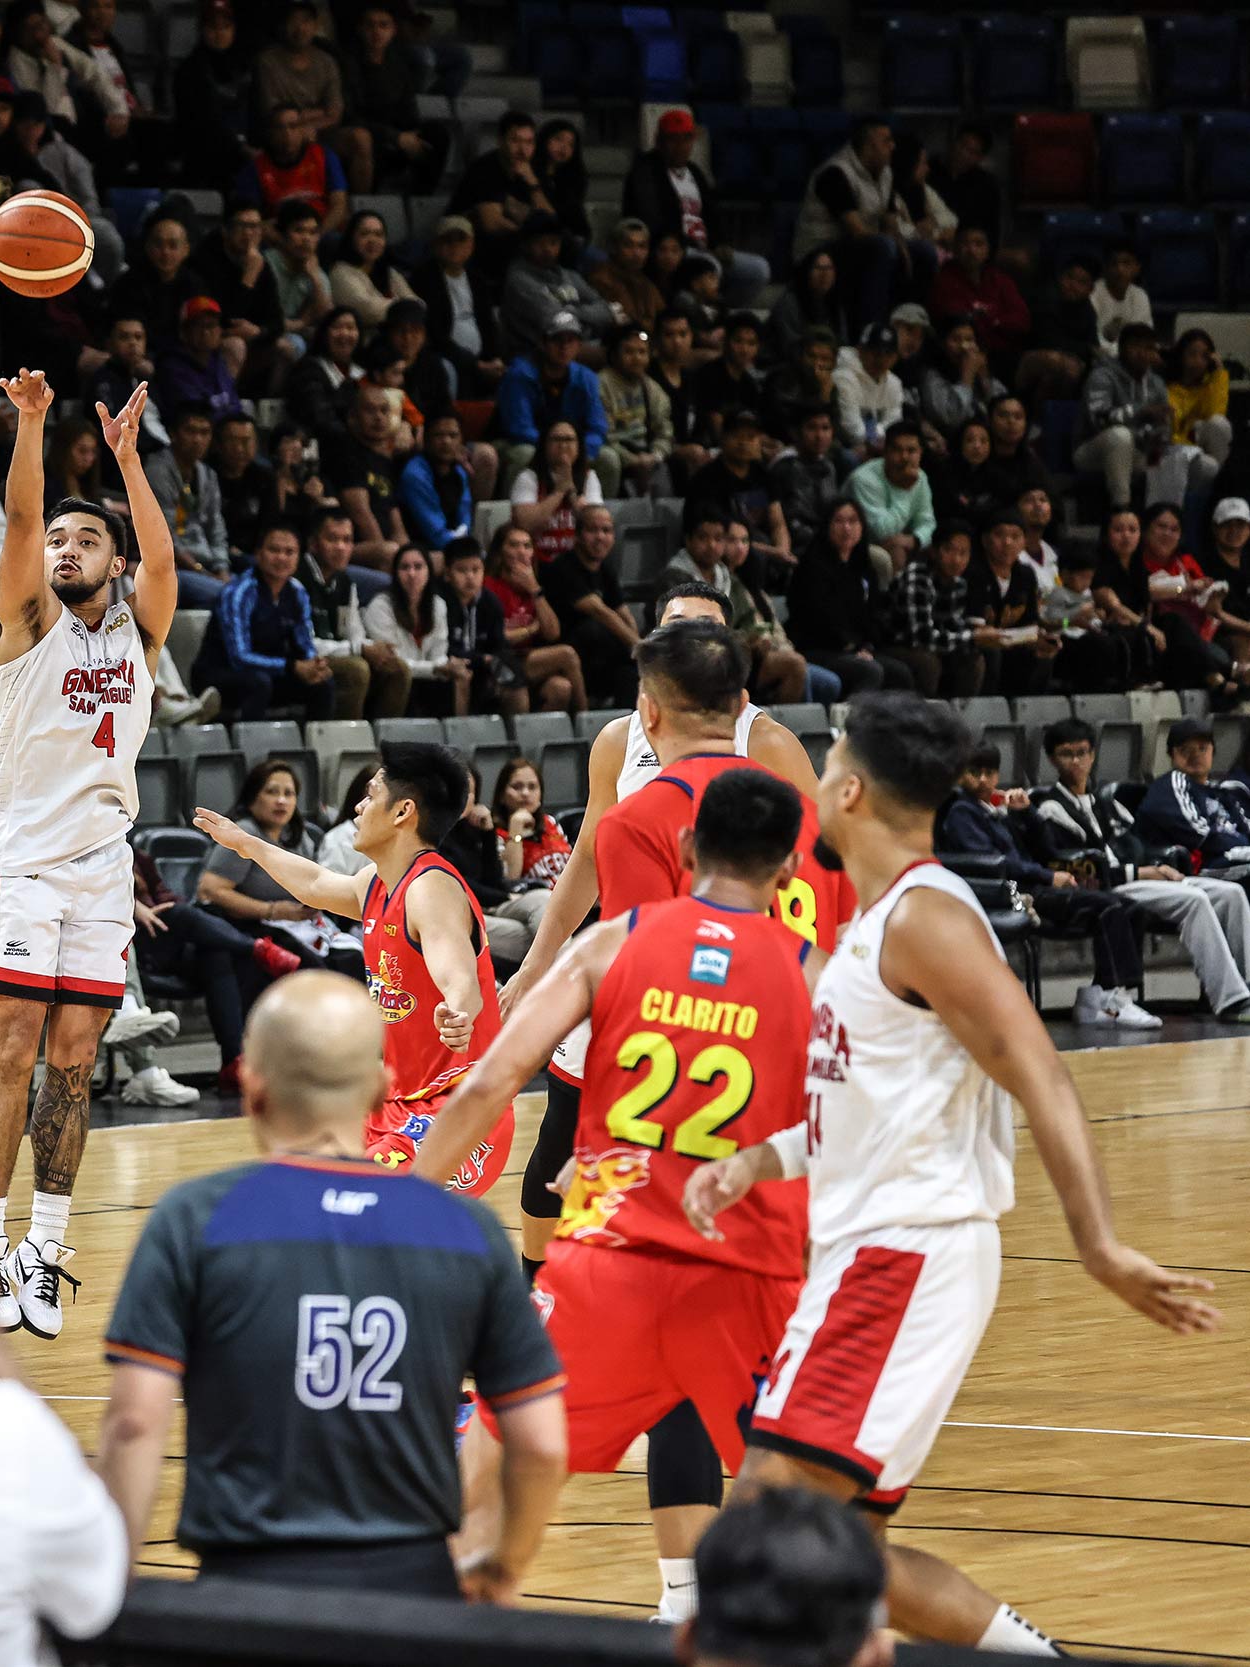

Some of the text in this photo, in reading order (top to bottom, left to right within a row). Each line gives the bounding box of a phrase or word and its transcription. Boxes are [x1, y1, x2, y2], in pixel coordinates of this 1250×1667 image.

[91, 711, 116, 758] 4
[640, 987, 759, 1040] CLARITO
[605, 1030, 754, 1162] 22
[295, 1293, 408, 1412] 52
